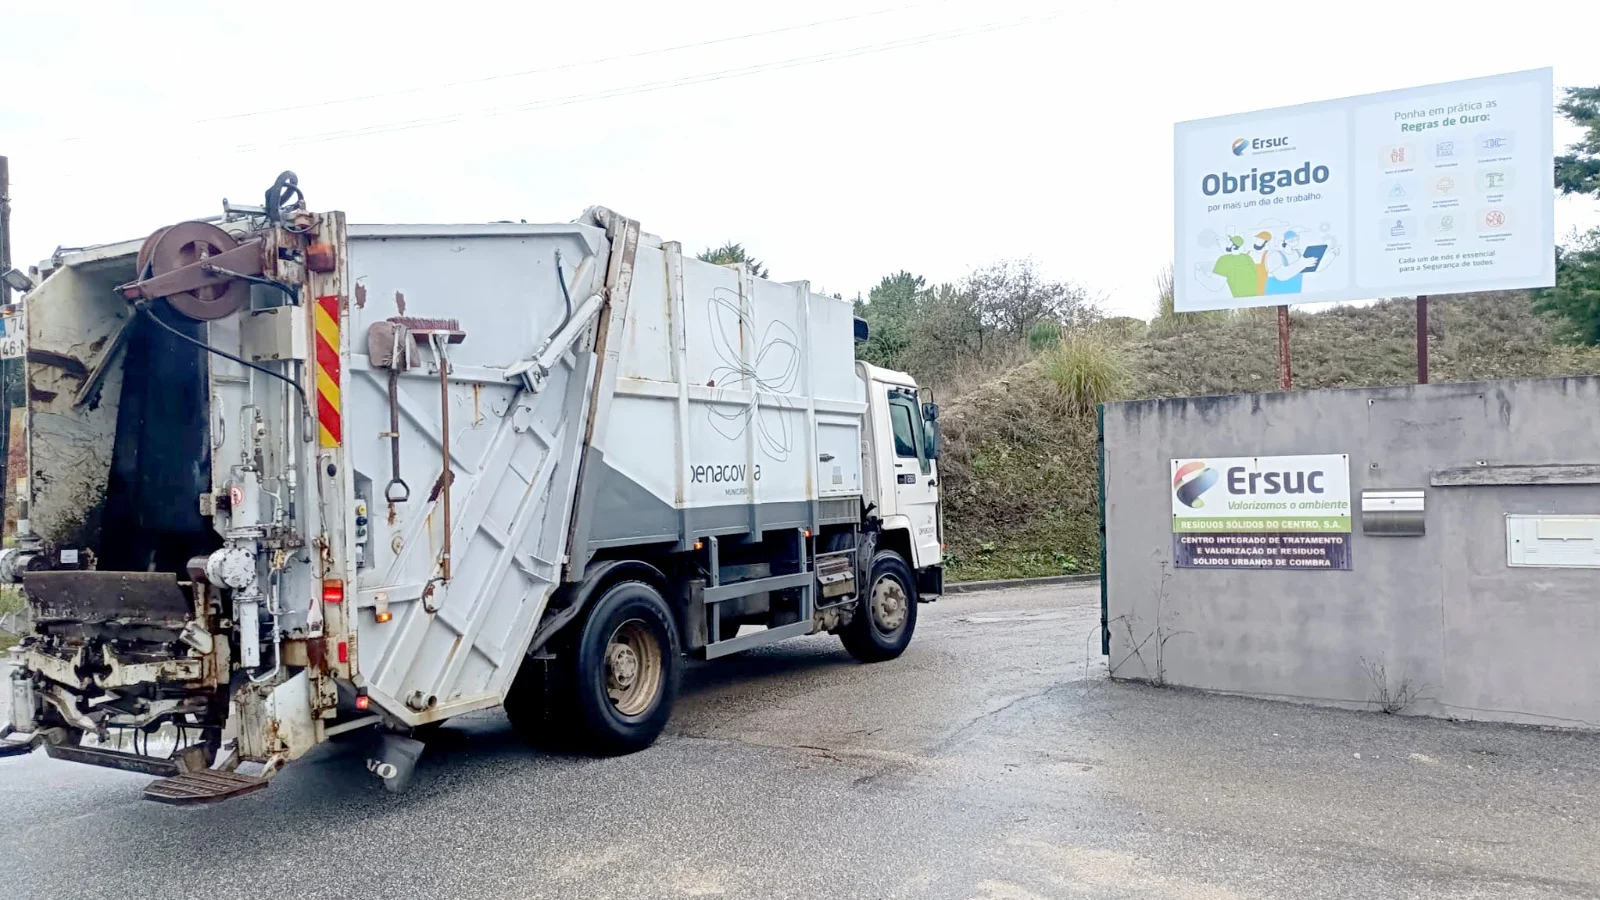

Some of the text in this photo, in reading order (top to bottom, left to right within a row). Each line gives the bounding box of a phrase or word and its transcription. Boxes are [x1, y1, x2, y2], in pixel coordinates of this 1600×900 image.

[1394, 100, 1497, 121] Ponha em prática as
[1401, 113, 1490, 132] Regras de Ouro:
[1252, 136, 1289, 150] Ersuc
[1202, 161, 1330, 196] Obrigado
[1207, 204, 1220, 213] por
[1223, 202, 1241, 211] mais
[1244, 200, 1256, 208] um
[1259, 197, 1271, 206] dia
[1273, 195, 1284, 204] de
[1398, 257, 1416, 265] Cada
[1417, 255, 1429, 263] um
[1430, 253, 1439, 261] de
[1462, 250, 1496, 259] essencial
[1399, 264, 1415, 273] para
[1422, 260, 1460, 272] Segurança
[1461, 259, 1471, 267] de
[1227, 466, 1325, 495] Ersuc
[1228, 500, 1348, 510] Valorizamos o ambiente
[1181, 519, 1341, 530] RESÍDUOS SÓLIDOS DO CENTRO, S.A.
[1283, 537, 1343, 545] TRATAMENTO
[1204, 546, 1265, 556] VALORIZAÇÃO
[1266, 547, 1277, 555] DE
[1280, 546, 1326, 555] RESÍDUOS
[1193, 557, 1229, 566] SÓLIDOS
[1231, 558, 1273, 566] URBANOS
[1275, 558, 1287, 566] DE
